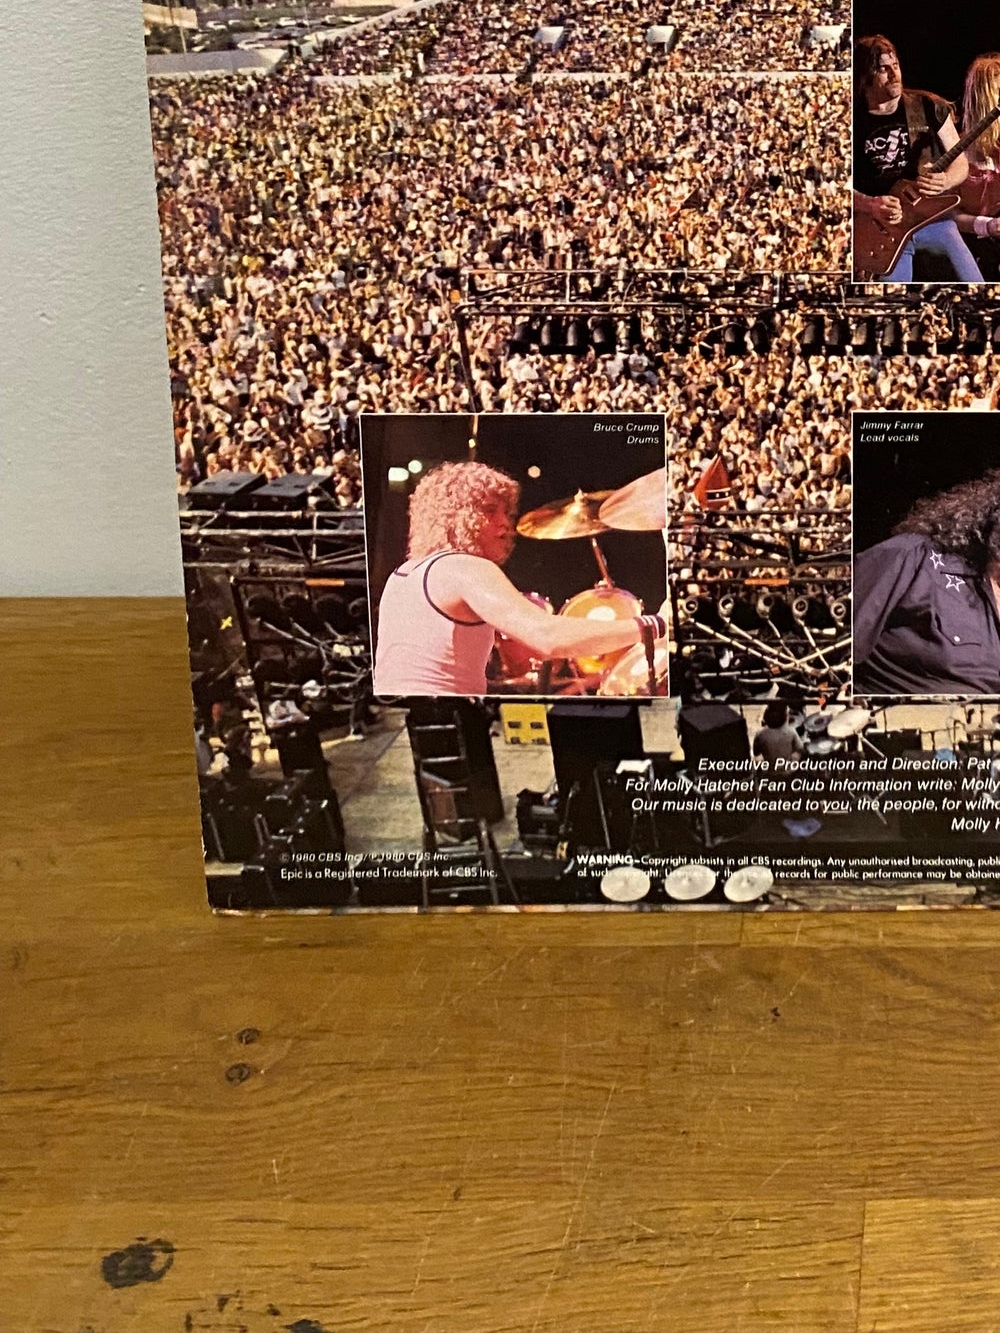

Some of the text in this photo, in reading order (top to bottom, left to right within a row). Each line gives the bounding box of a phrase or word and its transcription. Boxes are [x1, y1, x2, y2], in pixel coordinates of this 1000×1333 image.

[593, 422, 659, 433] Bruce Crump
[860, 421, 892, 432] Jimmy
[626, 435, 659, 444] Drums
[860, 434, 920, 442] Lead vocals
[698, 757, 769, 771] Executive
[774, 757, 855, 771] Production
[859, 758, 888, 770] and
[967, 757, 991, 770] Pat
[625, 778, 650, 792] For
[654, 778, 693, 795] Molly
[697, 778, 754, 792] Hatchet
[759, 778, 786, 792] Fan
[791, 778, 824, 792] Club
[829, 778, 912, 792] Information
[917, 778, 958, 791] write:
[961, 778, 1000, 793] Molly
[631, 798, 659, 811] Our
[662, 799, 707, 811] music
[710, 798, 723, 811] is
[726, 798, 802, 811] dedicated
[805, 798, 819, 811] to
[822, 800, 853, 814] you,
[857, 798, 880, 811] the
[883, 798, 938, 814] people,
[941, 798, 962, 811] for
[951, 817, 990, 833] Molly
[280, 866, 498, 881] Epic is a Registered Trademark of CBS Inc.
